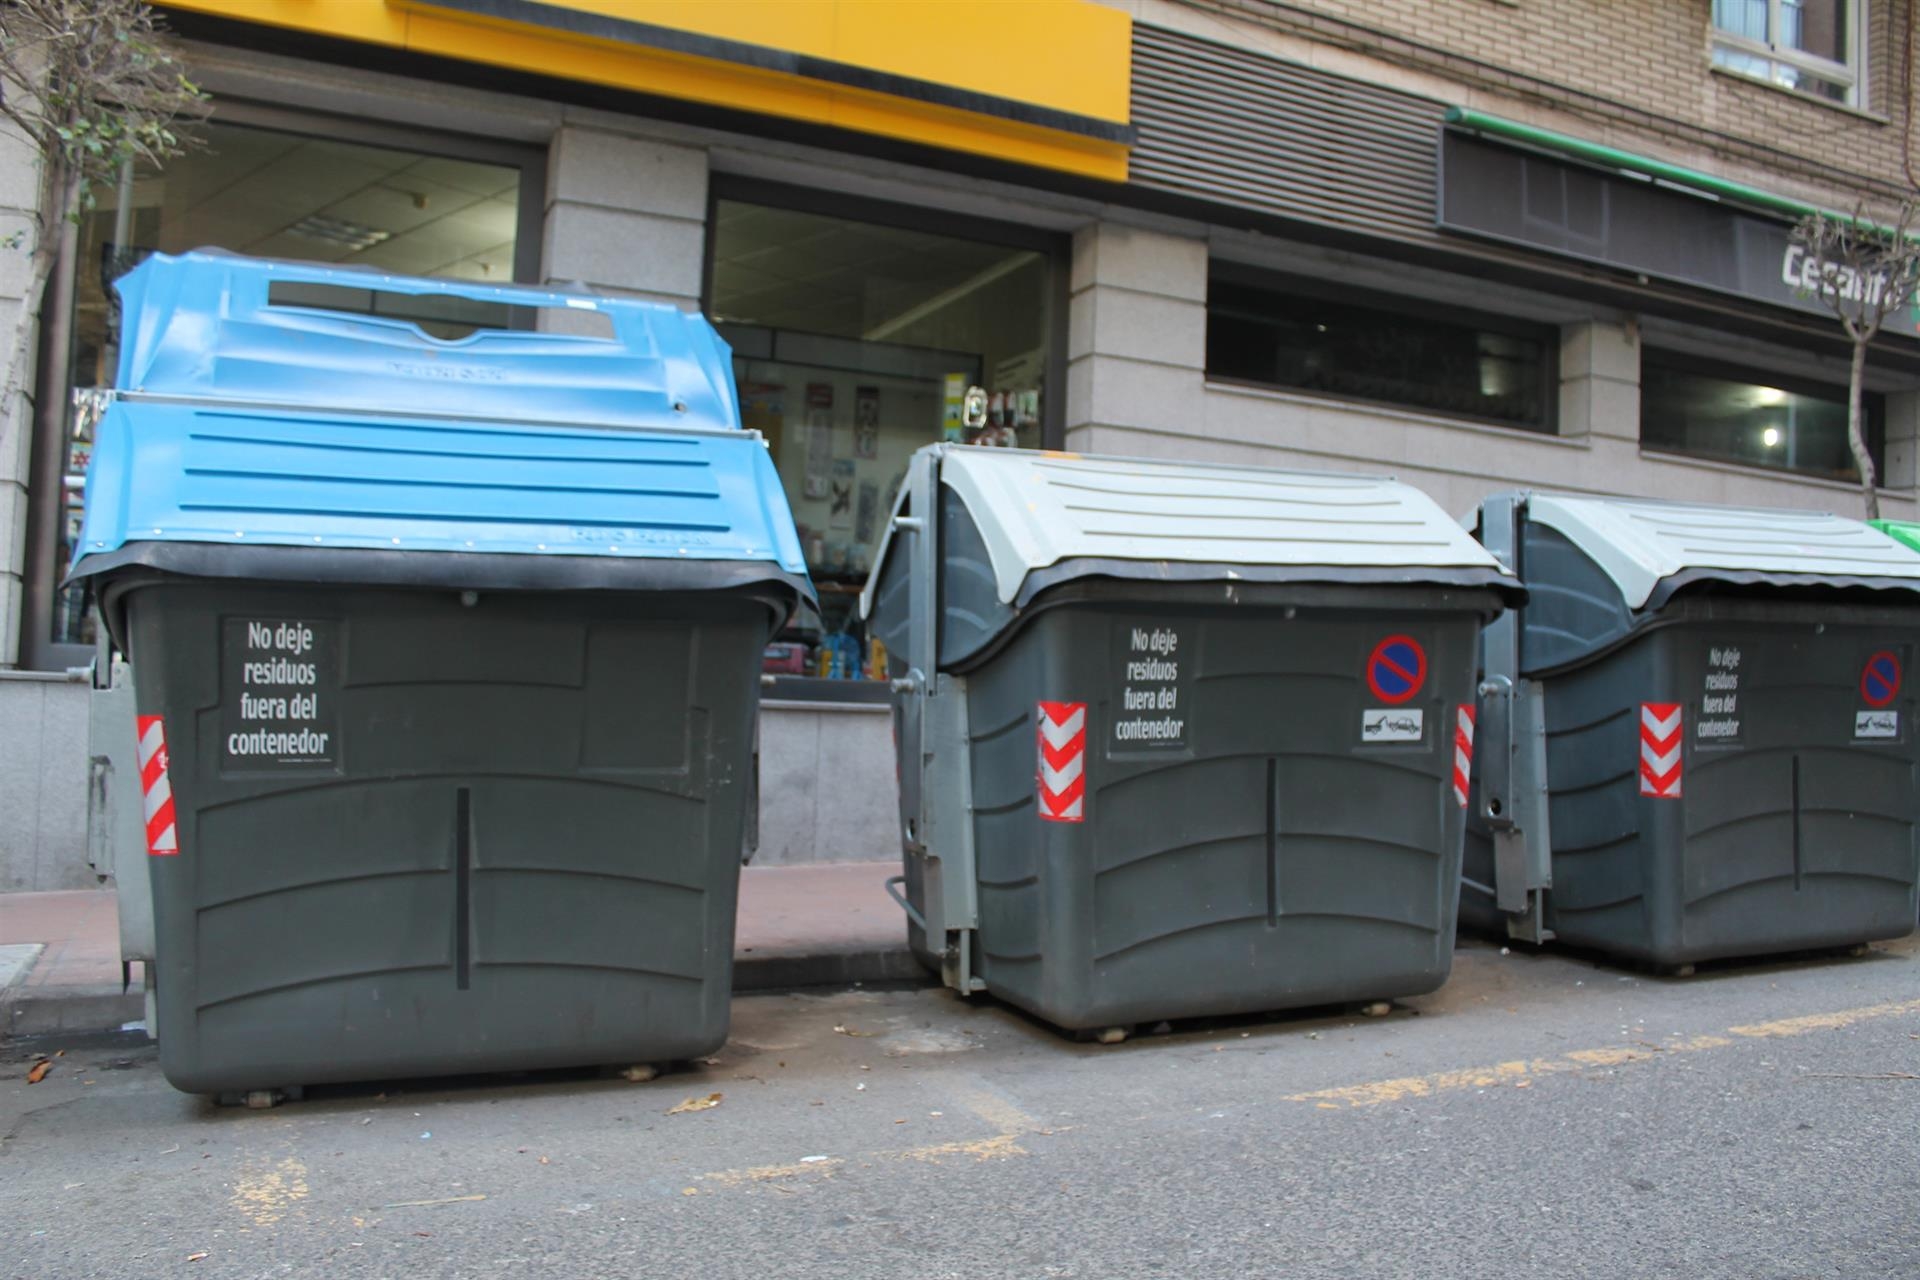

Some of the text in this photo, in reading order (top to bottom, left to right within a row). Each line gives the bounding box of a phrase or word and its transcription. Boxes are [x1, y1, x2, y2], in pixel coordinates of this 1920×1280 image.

[248, 622, 313, 655] No deje
[1131, 629, 1178, 656] No deje
[244, 657, 316, 685] residuos
[1127, 657, 1178, 681] residuos
[1709, 647, 1741, 671] No deje
[1705, 671, 1739, 691] residuos
[240, 692, 317, 720] fuera del
[1124, 686, 1177, 711] fuera del
[1702, 694, 1737, 714] fuera del
[1115, 716, 1184, 741] contenedor
[1697, 717, 1740, 738] contenedor
[228, 728, 329, 755] contenedor
